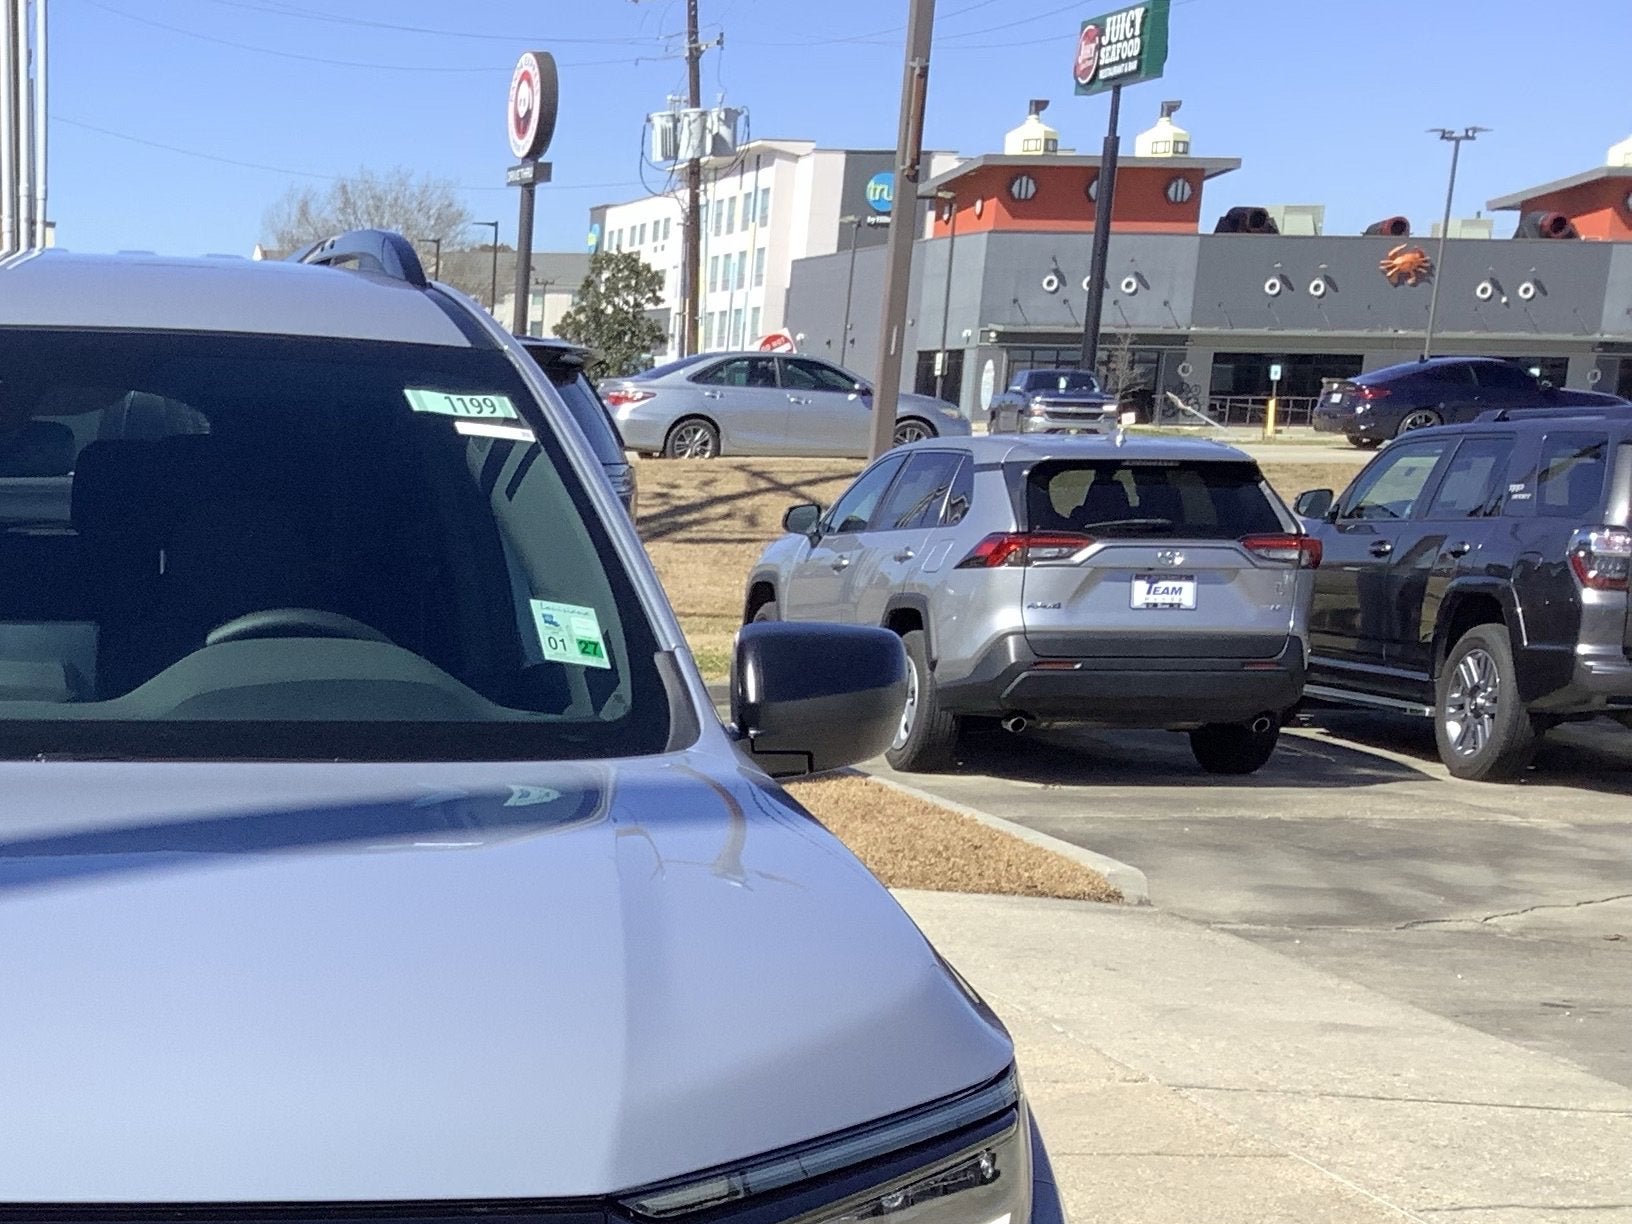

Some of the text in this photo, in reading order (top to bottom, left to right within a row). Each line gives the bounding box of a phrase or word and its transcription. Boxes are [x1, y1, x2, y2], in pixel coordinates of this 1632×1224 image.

[1101, 7, 1145, 45] JUICY
[1099, 37, 1141, 65] SEAFOOD
[867, 181, 893, 201] tru
[444, 396, 497, 415] 1199
[1146, 576, 1183, 596] TEAM
[547, 636, 567, 652] 01
[579, 641, 599, 656] 27
